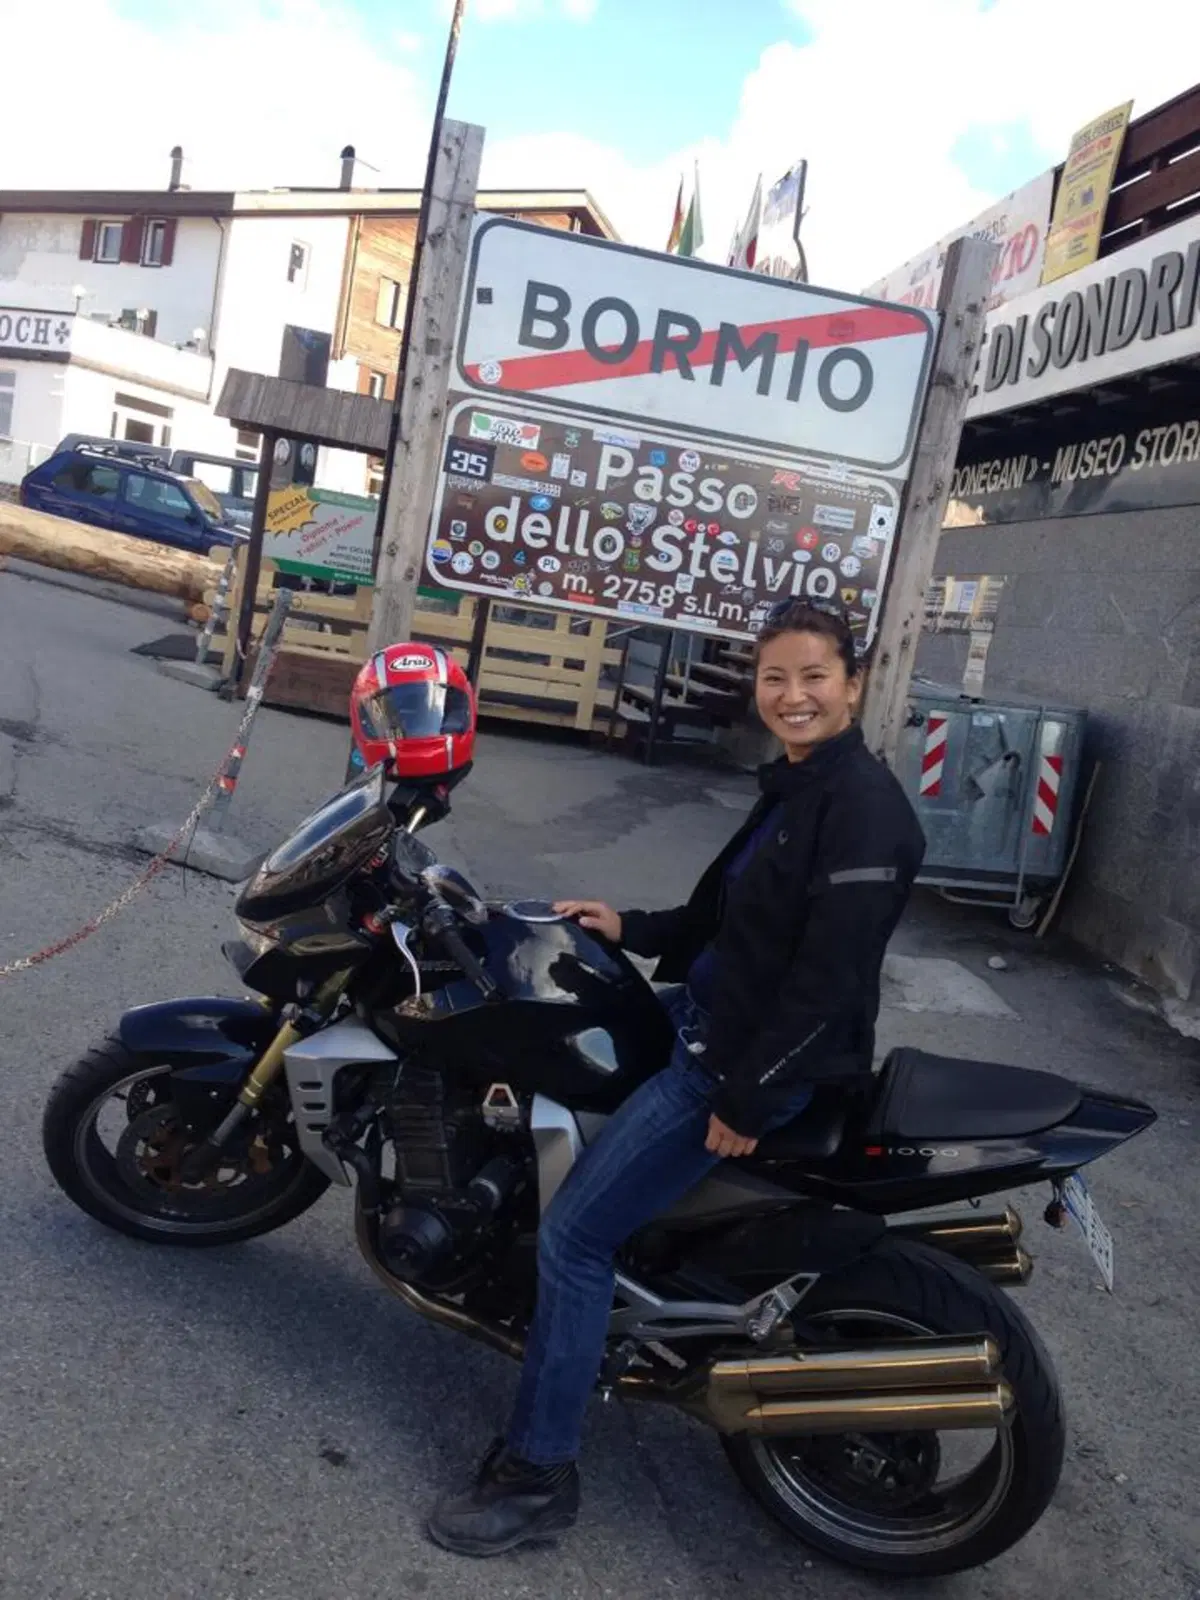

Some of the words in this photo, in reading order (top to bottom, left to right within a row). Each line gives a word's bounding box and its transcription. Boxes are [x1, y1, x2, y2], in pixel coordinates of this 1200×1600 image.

[518, 280, 874, 413] BORMIO
[983, 314, 1028, 392] DI
[1026, 238, 1200, 378] SONDRI
[450, 450, 488, 477] 35
[596, 444, 758, 519] Passo
[1050, 433, 1126, 482] MUSEO
[484, 496, 625, 561] dello
[645, 525, 837, 599] Stelvio
[562, 572, 595, 594] m.
[602, 573, 676, 608] 2758
[683, 593, 749, 622] s.l.m.
